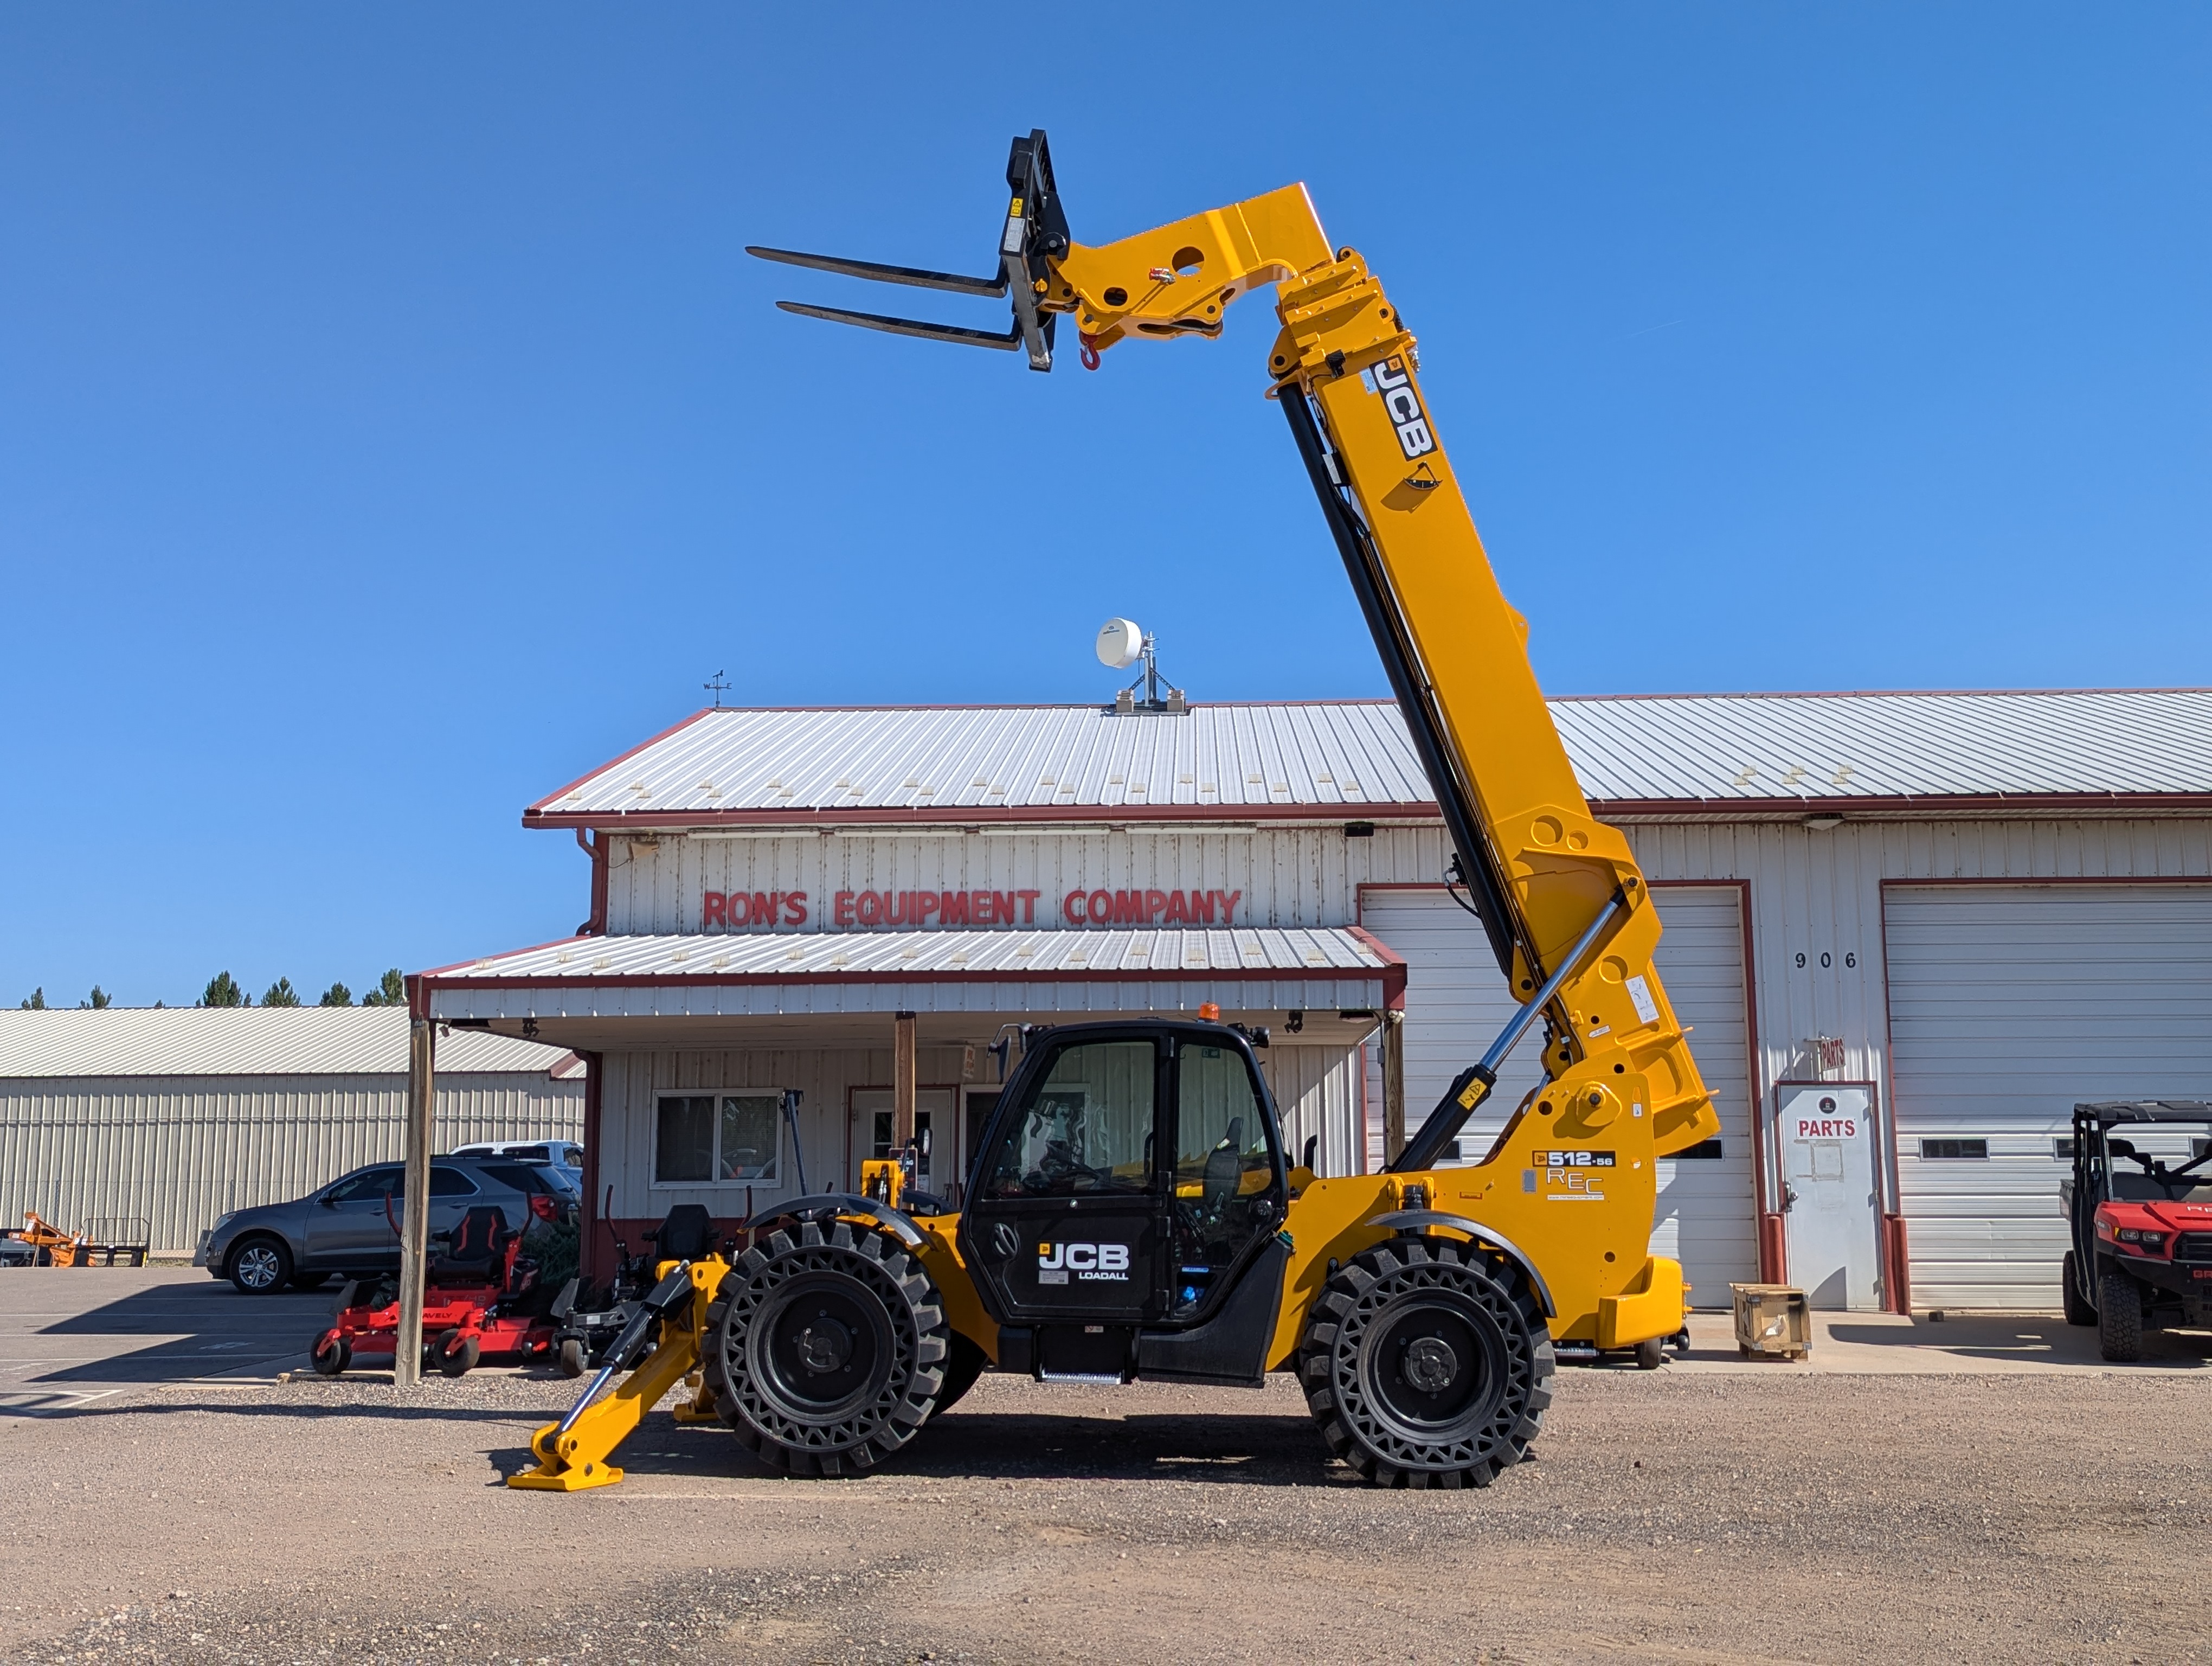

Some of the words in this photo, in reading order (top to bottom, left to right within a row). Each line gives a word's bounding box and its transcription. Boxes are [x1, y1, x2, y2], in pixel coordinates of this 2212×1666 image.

[1374, 362, 1432, 457] JCB
[704, 891, 807, 926] RON'S
[834, 890, 1040, 925] EQUIPMENT
[1064, 889, 1242, 924] COMPANY
[1822, 1038, 1844, 1068] PARTS
[1799, 1119, 1855, 1137] PARTS
[1548, 1152, 1613, 1166] 512-56
[1547, 1168, 1604, 1195] REC
[1039, 1243, 1129, 1270] JCB
[1078, 1271, 1129, 1280] LOADALL
